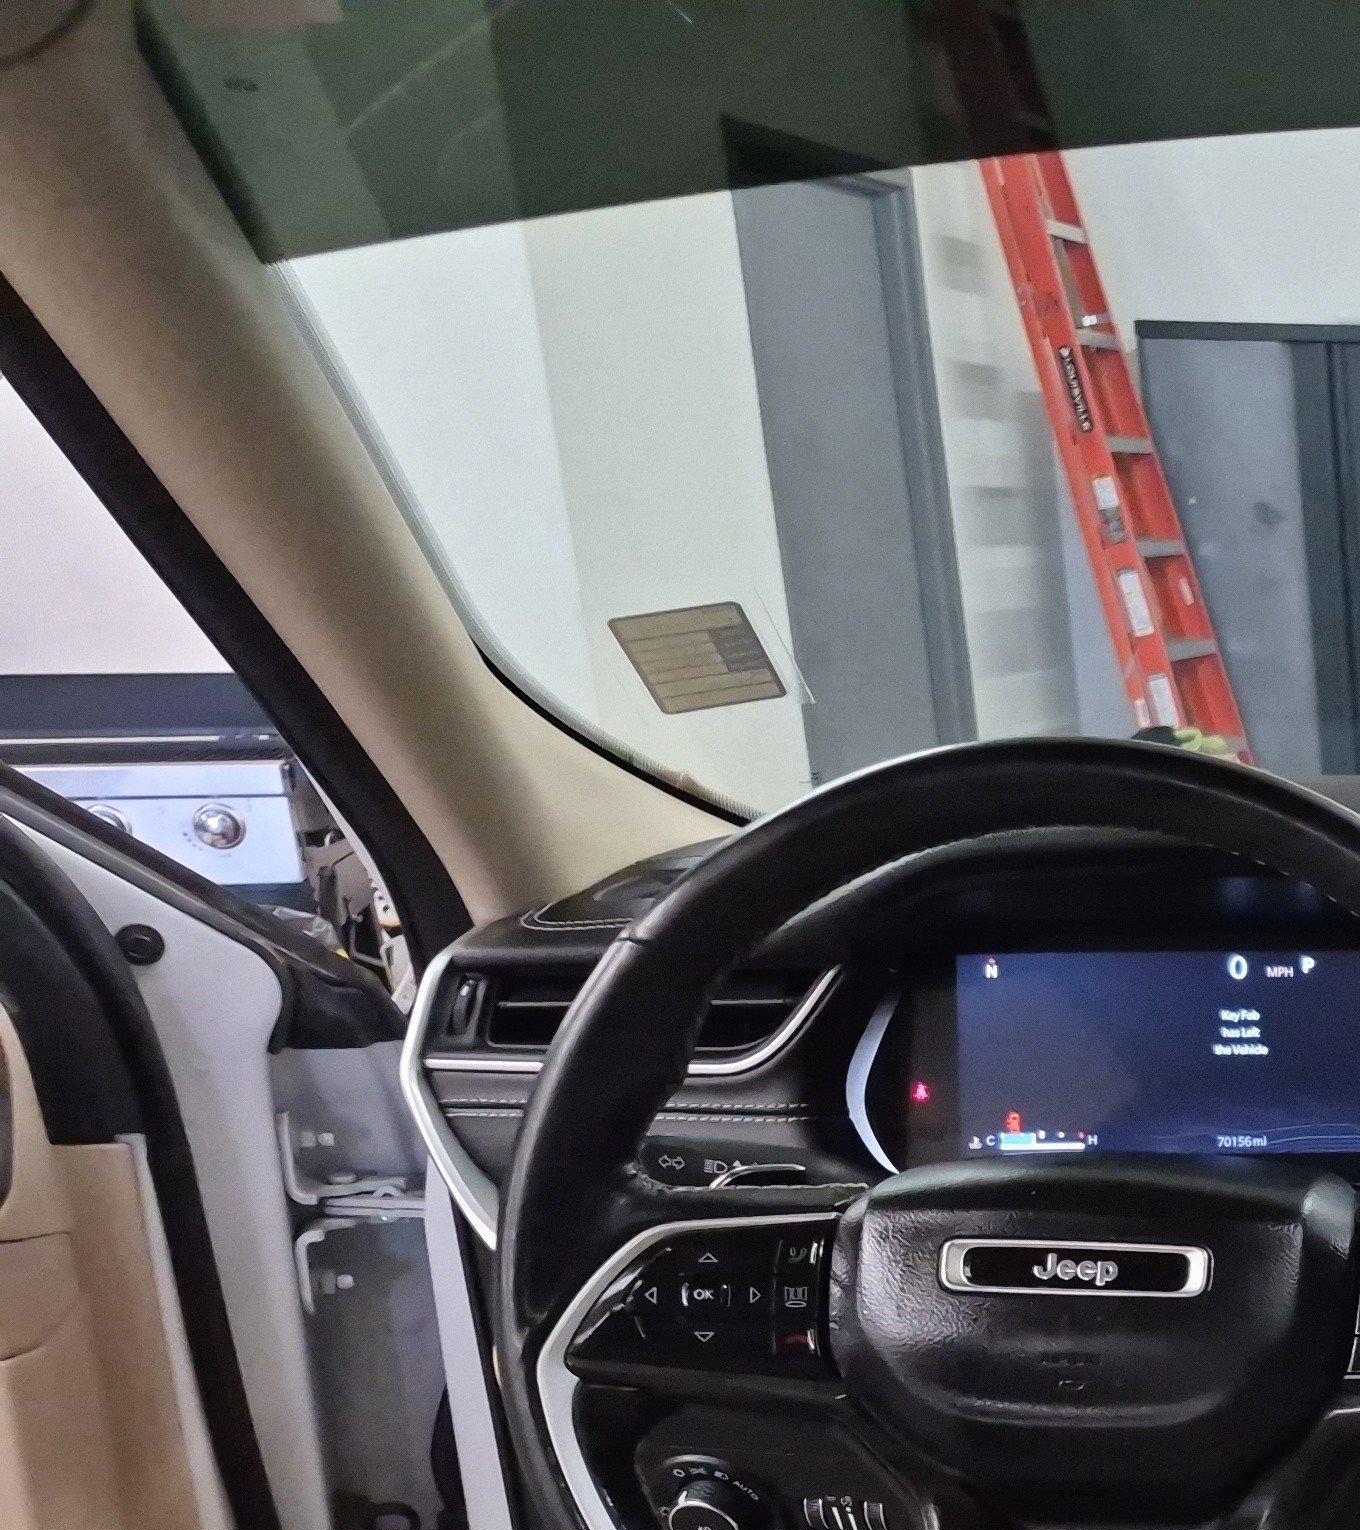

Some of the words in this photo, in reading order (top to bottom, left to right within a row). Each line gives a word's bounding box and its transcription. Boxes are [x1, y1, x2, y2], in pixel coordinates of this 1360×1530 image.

[985, 964, 998, 979] N
[1228, 953, 1248, 980] 0
[1265, 965, 1294, 978] MPH
[1300, 955, 1316, 974] P
[1220, 1008, 1239, 1022] Key
[1240, 1008, 1260, 1021] Fob
[1221, 1026, 1240, 1038] has
[1241, 1026, 1261, 1038] Left
[1213, 1043, 1231, 1055] the
[1232, 1043, 1269, 1055] Vehicle
[985, 1135, 996, 1147] C
[1088, 1134, 1098, 1146] H
[1031, 1252, 1119, 1287] Jeep
[693, 1288, 715, 1301] OK
[732, 1480, 759, 1501] AUTO
